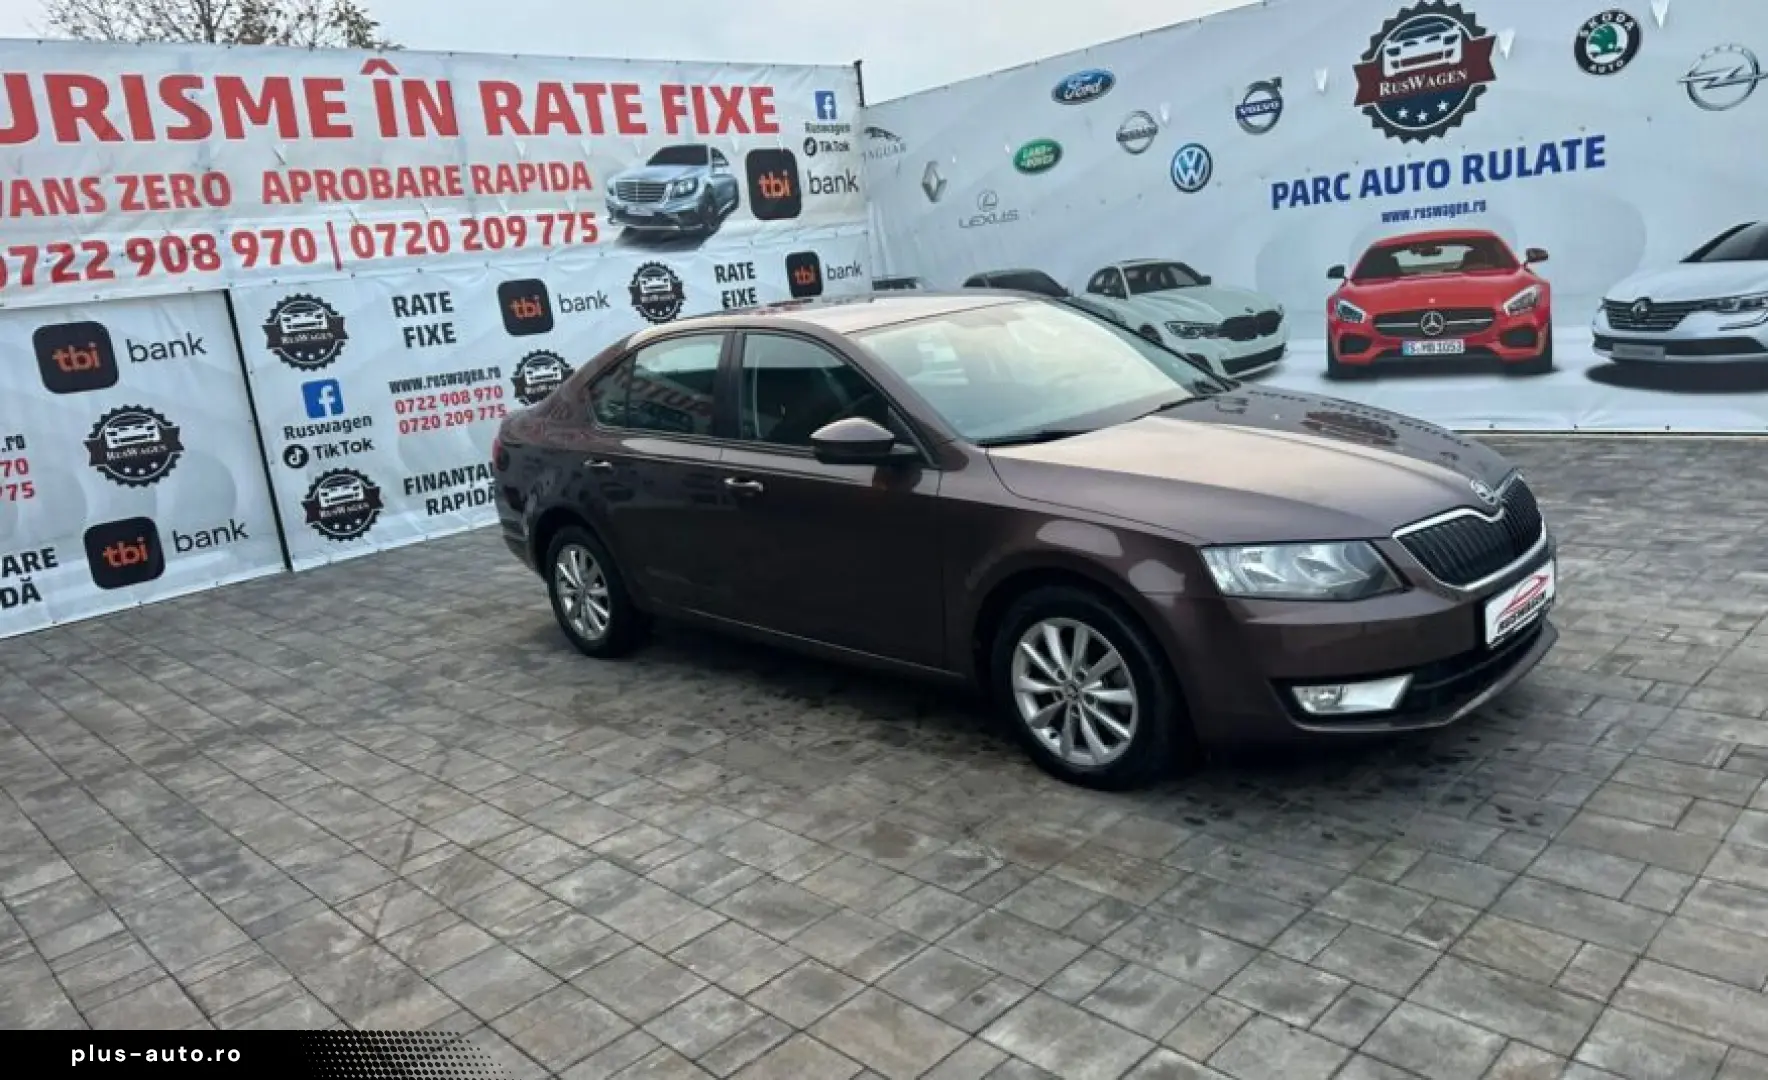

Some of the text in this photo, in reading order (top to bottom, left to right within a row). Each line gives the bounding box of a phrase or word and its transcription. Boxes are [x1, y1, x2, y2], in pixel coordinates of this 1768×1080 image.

[360, 58, 459, 137] ÎN
[479, 80, 648, 136] RATE
[660, 84, 780, 134] FIXE
[261, 161, 593, 204] APROBARE RAPIDA
[759, 166, 860, 198] tbi bank
[1271, 135, 1606, 210] PARC AUTO RULATE
[0, 171, 232, 218] ANS ZERO
[126, 233, 222, 276] 908
[231, 228, 318, 268] 970
[350, 219, 450, 259] 0720
[460, 215, 527, 251] 209
[537, 212, 598, 246] 775
[714, 261, 756, 284] RATE
[794, 259, 863, 285] tbi bank
[392, 290, 455, 318] RATE
[509, 291, 611, 321] tbi bank
[721, 287, 758, 310] FIXE
[403, 322, 457, 349] FIXE
[53, 332, 208, 373] tbi bank
[395, 395, 437, 415] 0722
[440, 389, 471, 406] 908
[474, 384, 504, 403] 970
[283, 415, 373, 441] Ruswagen
[399, 403, 507, 435] 0720 209 775
[312, 437, 375, 461] TikTok
[102, 518, 250, 568] tbi bank
